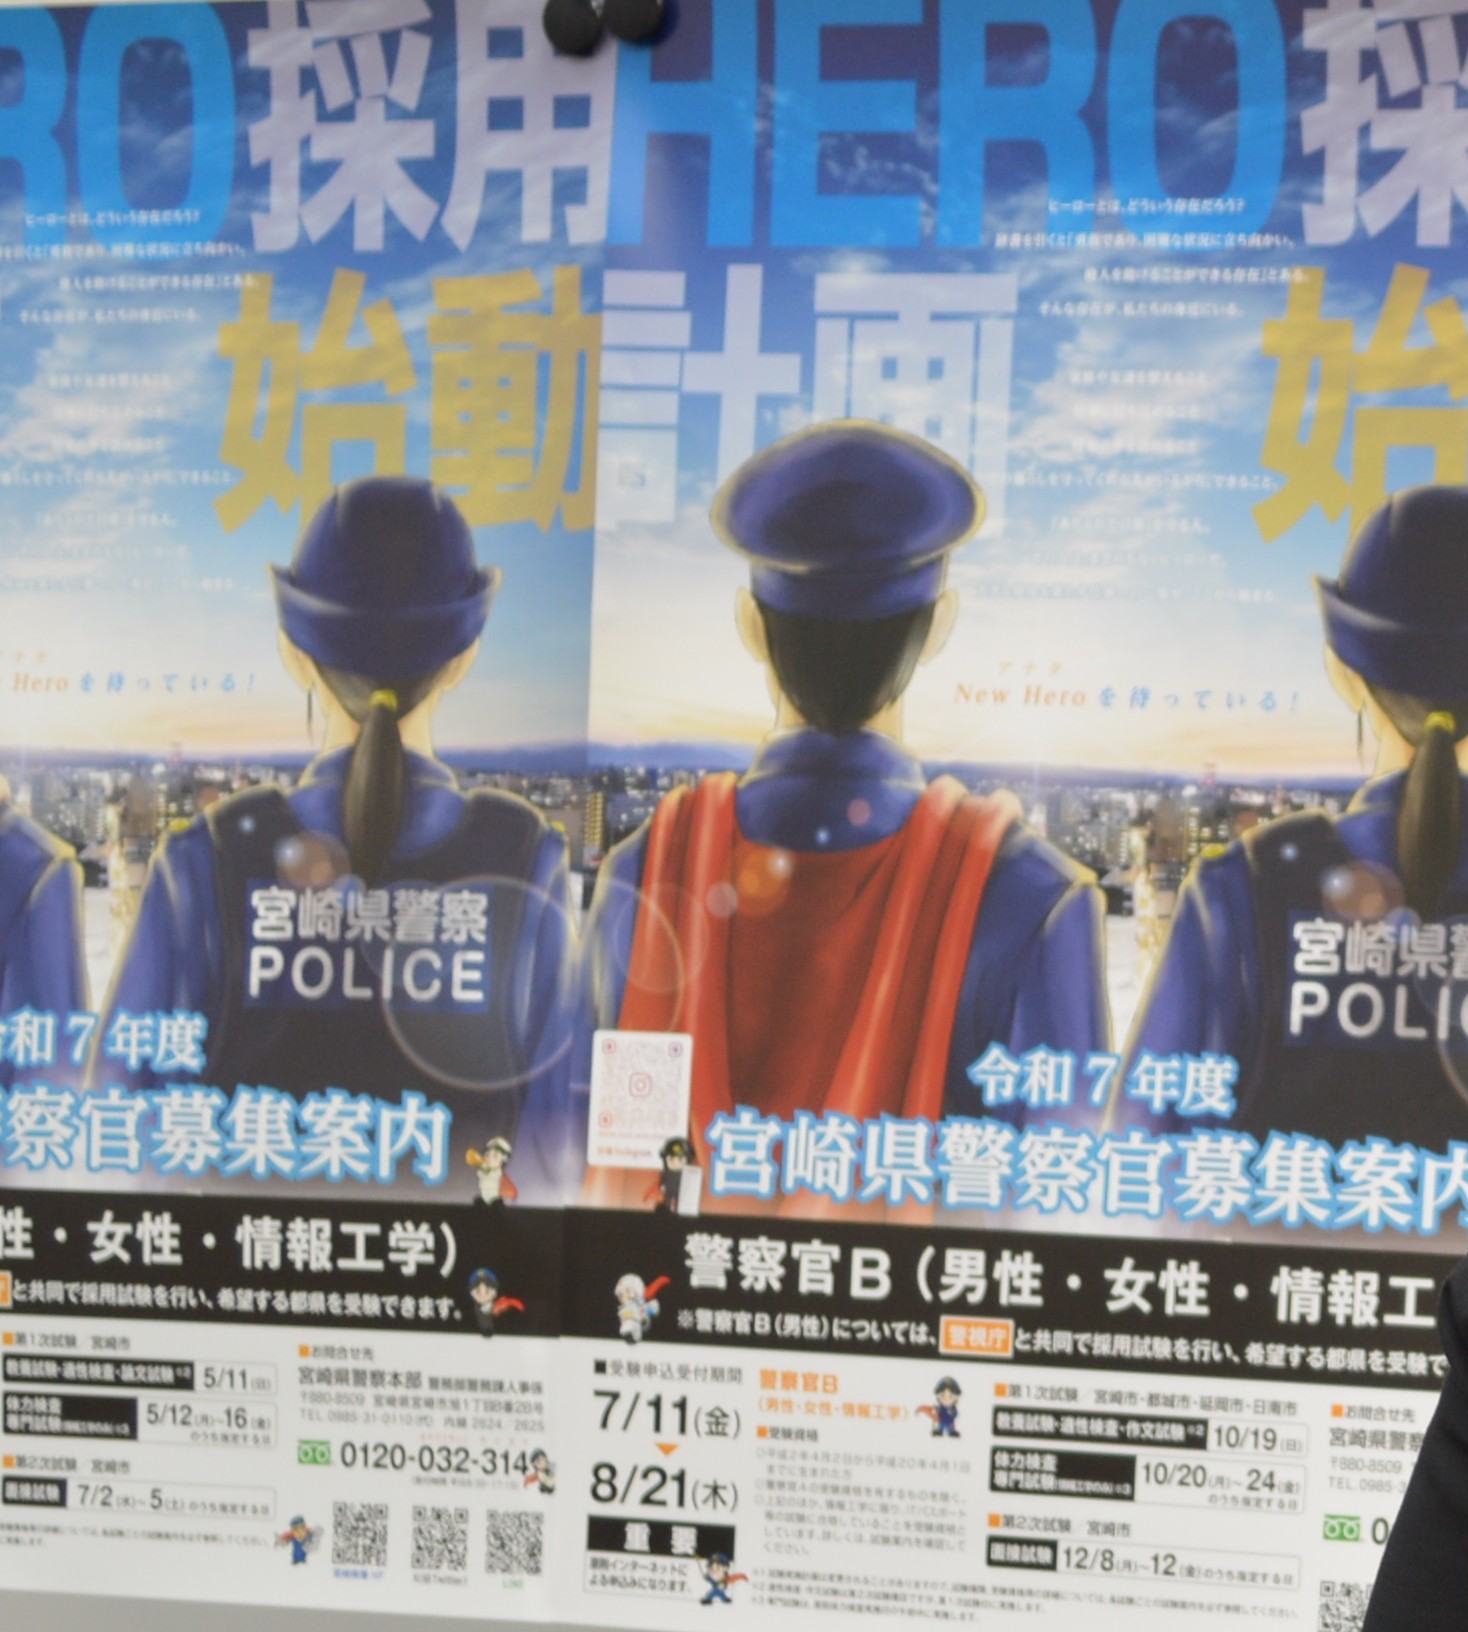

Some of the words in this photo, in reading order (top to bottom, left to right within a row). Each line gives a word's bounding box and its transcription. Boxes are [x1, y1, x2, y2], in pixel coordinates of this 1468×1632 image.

[213, 264, 604, 533] 始動
[954, 682, 1010, 706] New
[1022, 683, 1087, 707] Hero
[251, 887, 488, 944] 宮崎県警察
[250, 949, 485, 1002] POLICE
[0, 1010, 205, 1073] 和7年度
[970, 1047, 1235, 1111] 令和7年度
[0, 1086, 447, 1180] 察官募集案内
[340, 1441, 529, 1475] 0120-032-314
[589, 1461, 740, 1512] 8/21(木)
